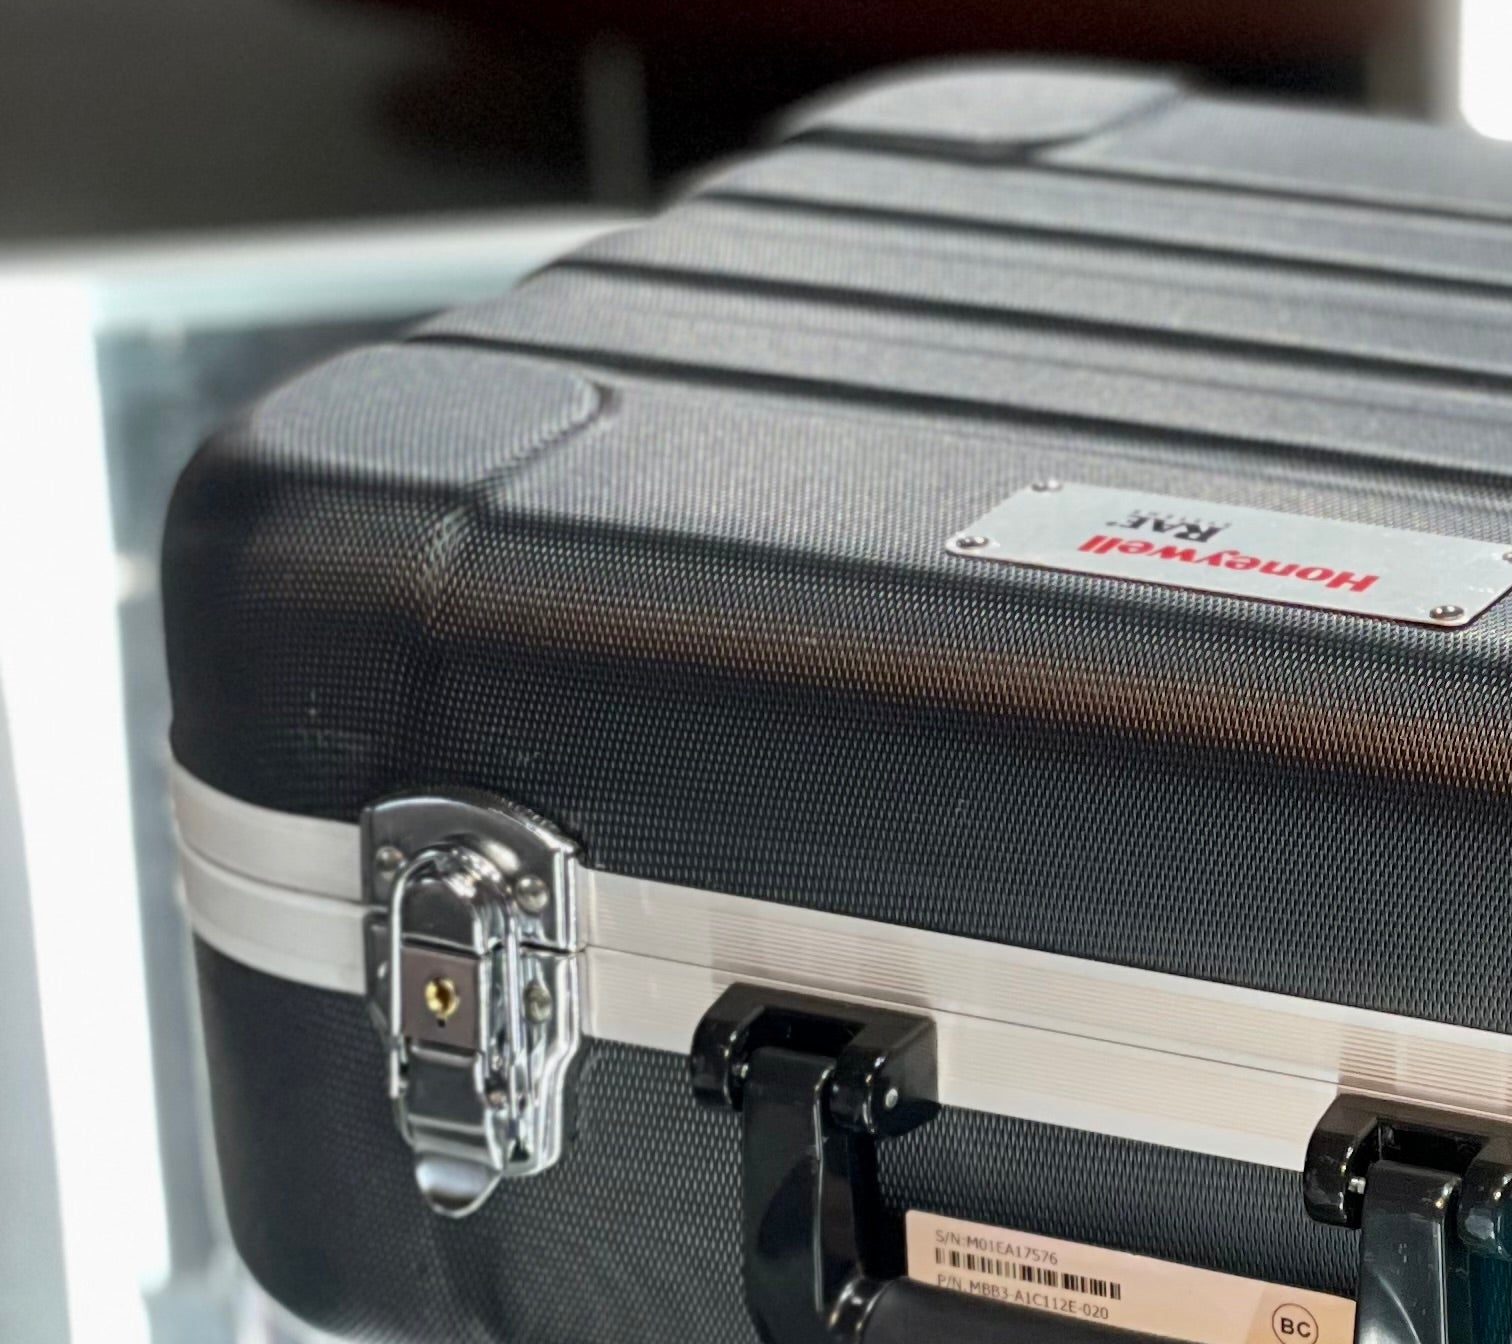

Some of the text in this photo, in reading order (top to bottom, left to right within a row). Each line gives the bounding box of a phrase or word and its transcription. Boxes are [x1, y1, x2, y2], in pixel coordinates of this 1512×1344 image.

[1118, 516, 1223, 543] RAE
[1077, 534, 1380, 593] Honeywell
[1281, 1317, 1312, 1338] BC
